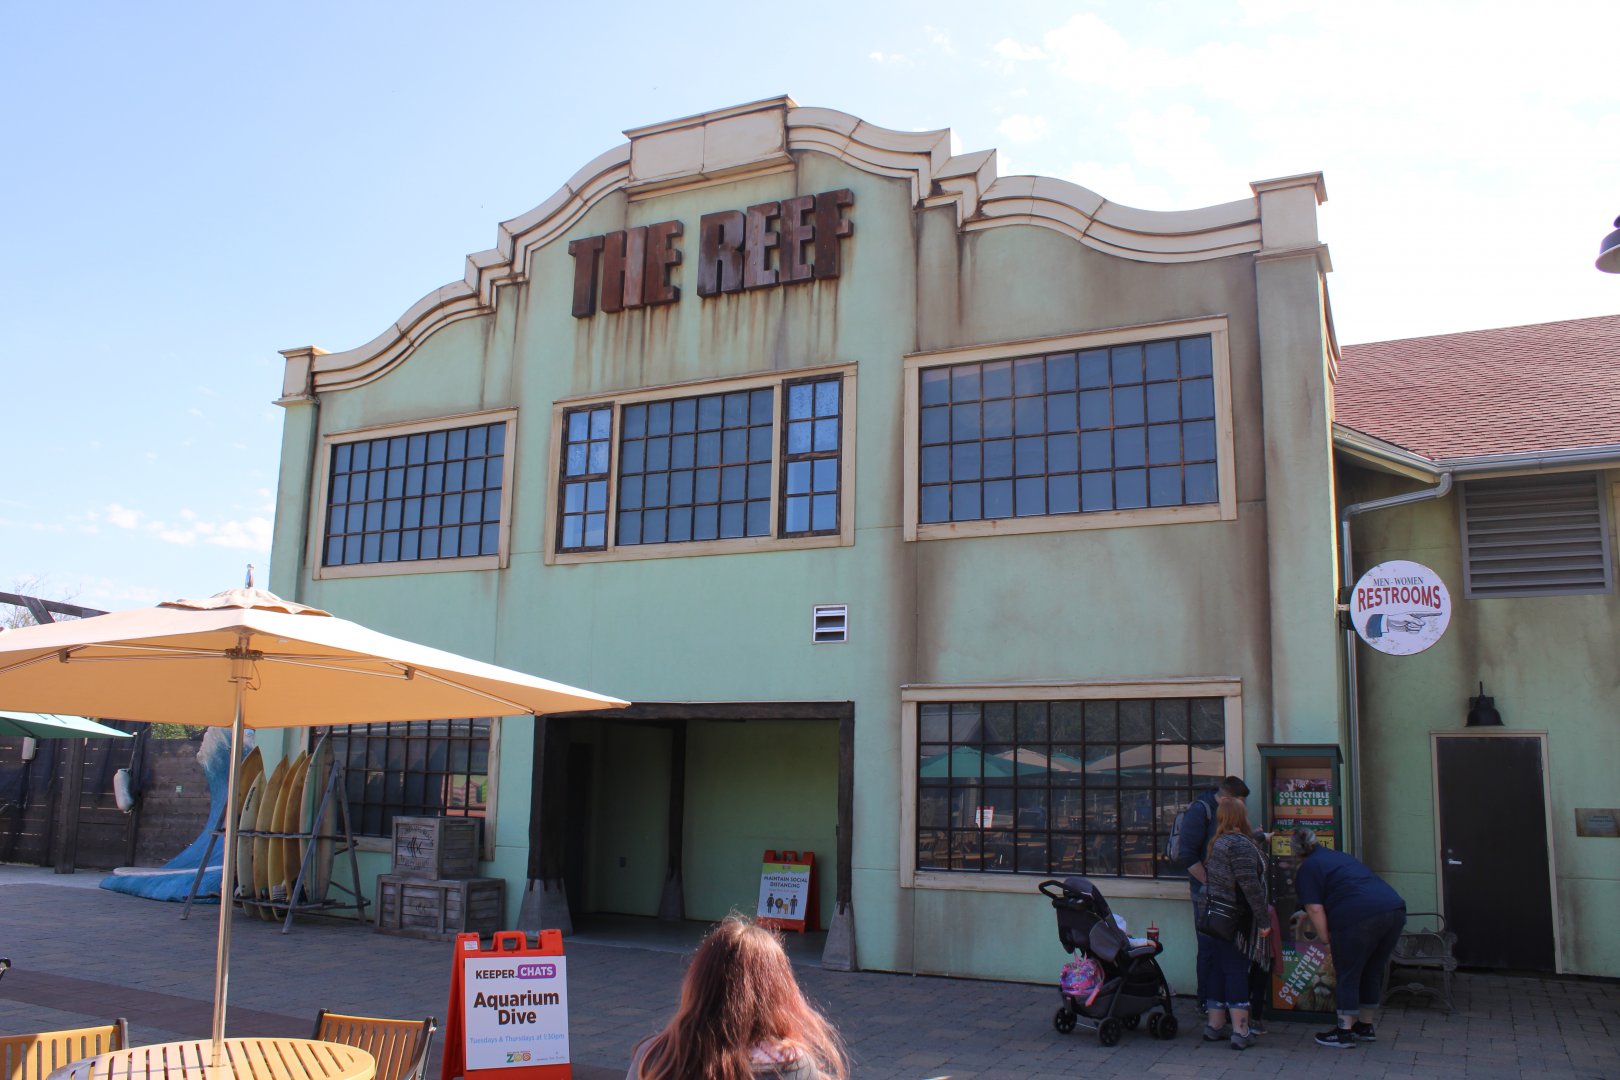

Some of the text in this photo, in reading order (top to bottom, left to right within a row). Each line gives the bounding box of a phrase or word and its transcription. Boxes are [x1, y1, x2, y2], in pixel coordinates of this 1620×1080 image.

[568, 188, 854, 319] THE REEF
[1357, 585, 1441, 612] RESTROOMS
[1279, 791, 1330, 799] COLLECTIBLE
[475, 966, 553, 979] KEEPER CHATS
[1279, 945, 1318, 998] COLLECTIBLE
[1285, 950, 1325, 1005] PENNIES
[473, 990, 559, 1010] Aquarium
[498, 1009, 537, 1025] Dive
[505, 1034, 535, 1042] Thursdays
